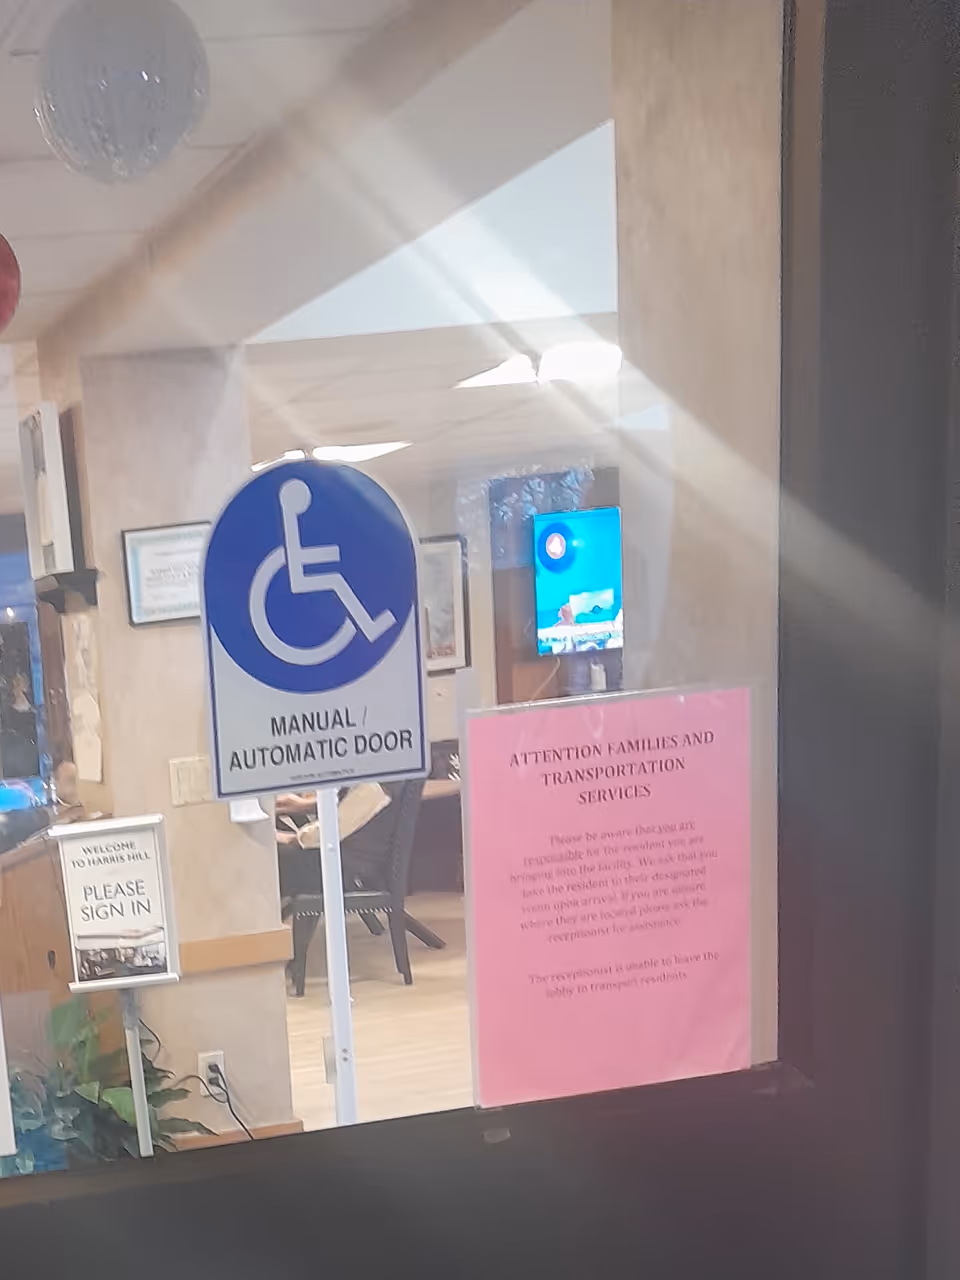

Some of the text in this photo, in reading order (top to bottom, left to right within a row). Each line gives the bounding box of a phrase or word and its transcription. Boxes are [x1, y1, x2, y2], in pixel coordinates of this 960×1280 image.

[270, 707, 356, 738] MANUAL
[229, 729, 413, 772] AUTOMATIC DOOR
[510, 730, 715, 767] ATTENTION FAMILIES AND
[541, 757, 686, 786] TRANSPORTATION
[577, 784, 652, 804] SERVICES
[71, 850, 151, 869] TO HARRIS HILL
[82, 841, 136, 855] WELCOME
[83, 879, 146, 902] PLEASE
[80, 899, 152, 922] SIGN IN
